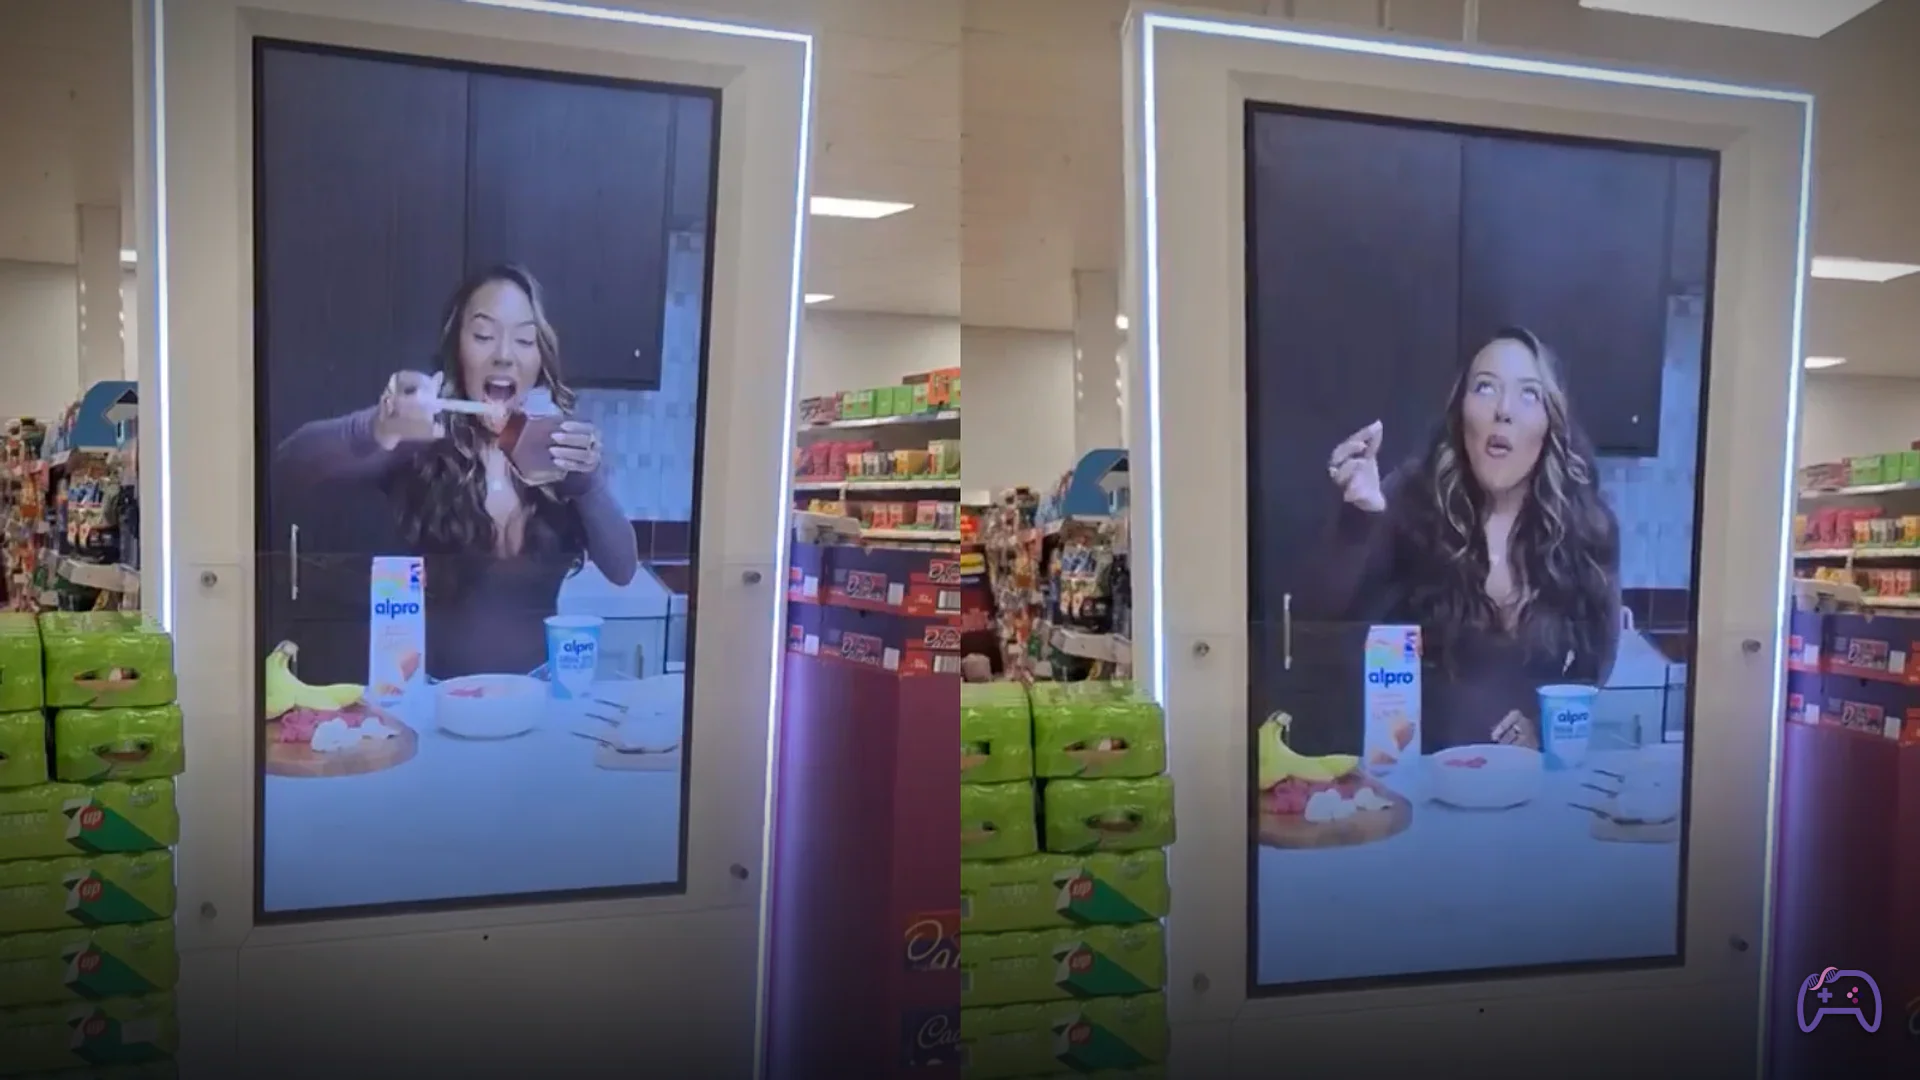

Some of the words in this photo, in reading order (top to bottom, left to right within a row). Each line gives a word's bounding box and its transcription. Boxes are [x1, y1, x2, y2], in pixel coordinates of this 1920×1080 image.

[375, 598, 420, 620] alpro
[563, 639, 595, 656] alpro
[1368, 666, 1414, 689] alpro
[1557, 708, 1589, 726] alpro
